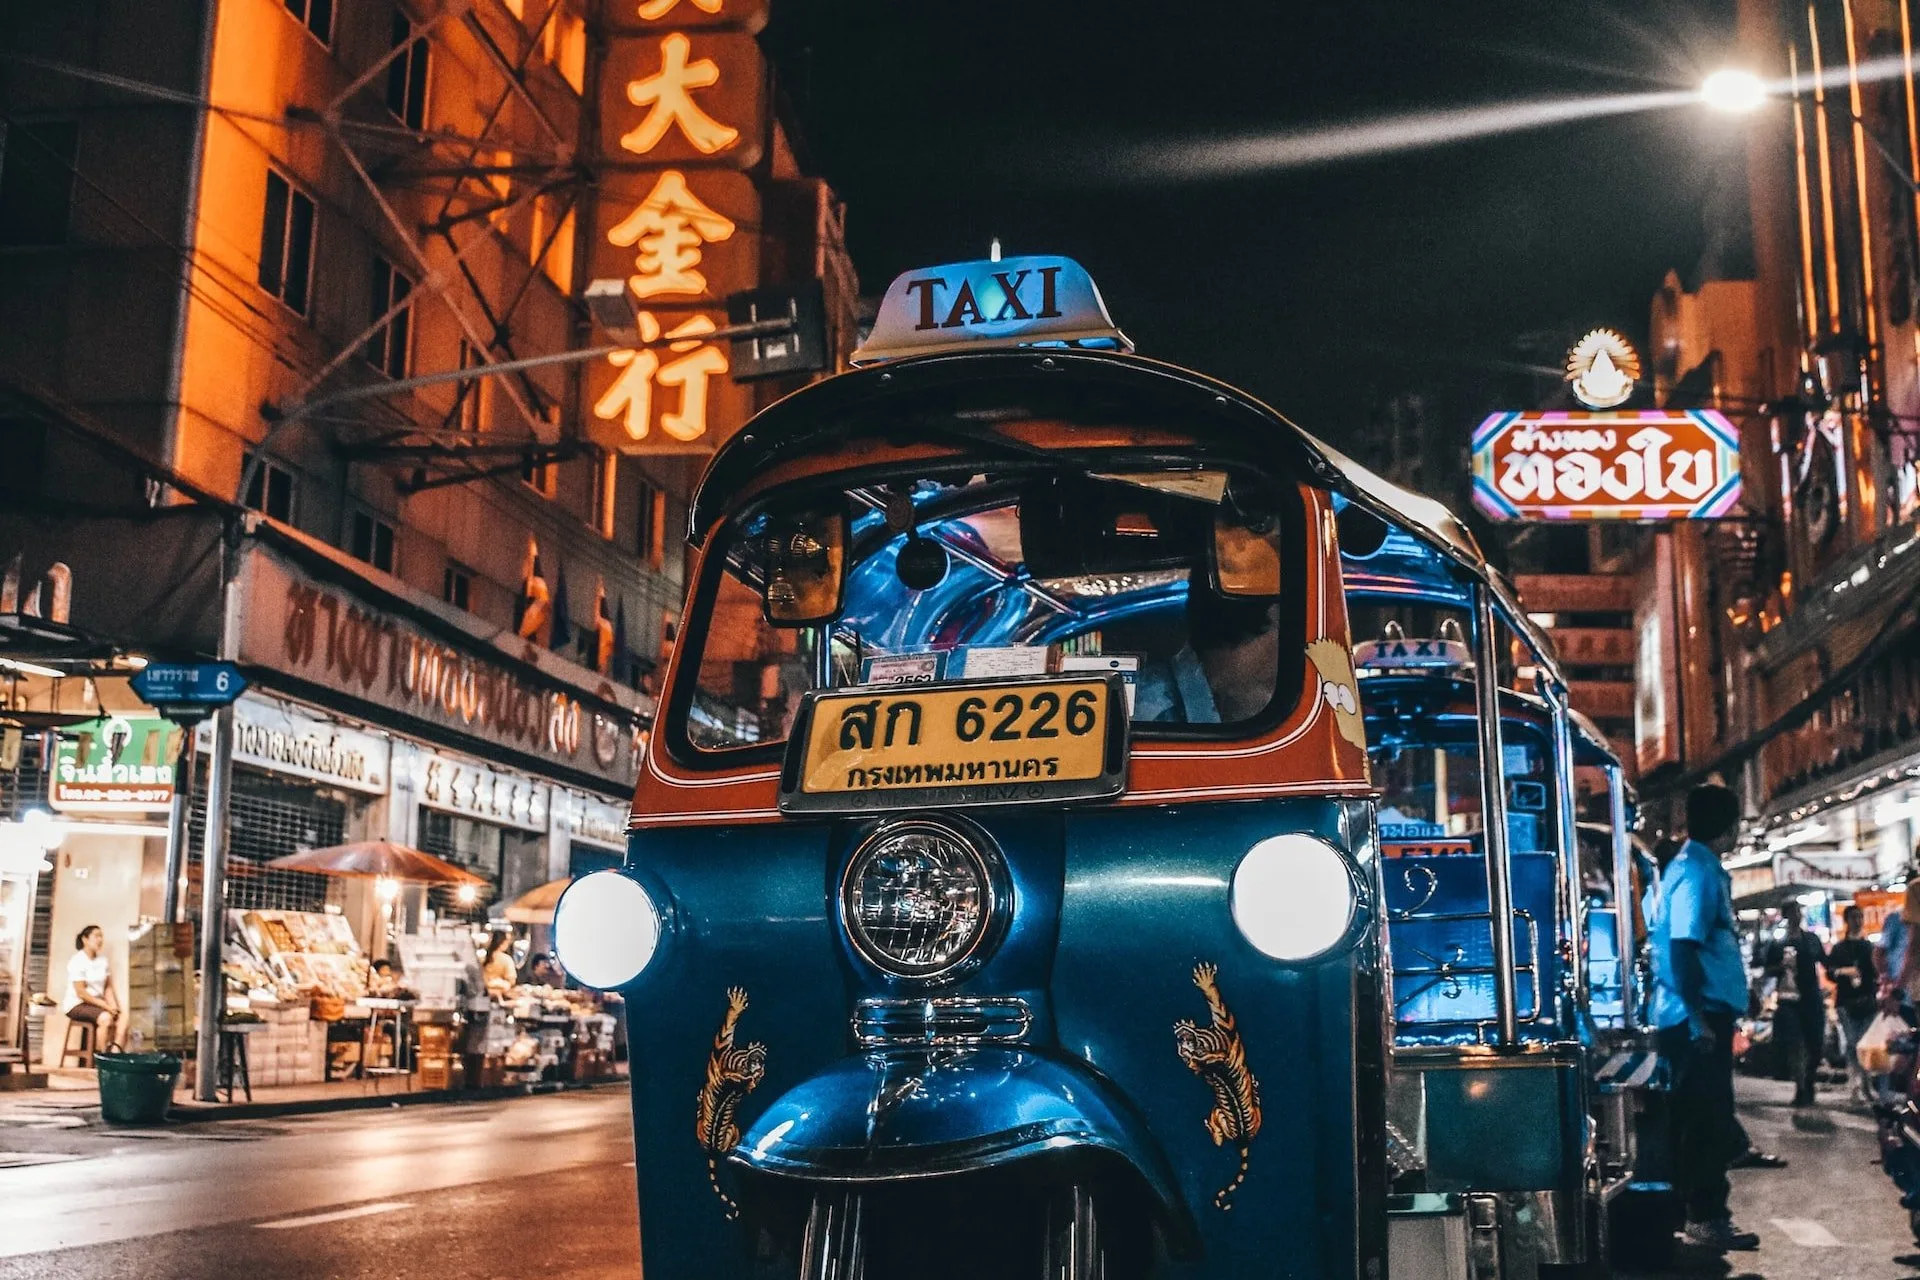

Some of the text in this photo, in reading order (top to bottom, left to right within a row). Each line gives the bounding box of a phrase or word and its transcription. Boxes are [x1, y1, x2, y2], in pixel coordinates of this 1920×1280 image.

[594, 0, 739, 441] 大金行
[906, 266, 1062, 331] TAXI
[1499, 427, 1713, 501] ทองใบ
[216, 670, 230, 692] 6
[1375, 642, 1448, 658] TAXI
[839, 690, 1097, 750] สก 6226
